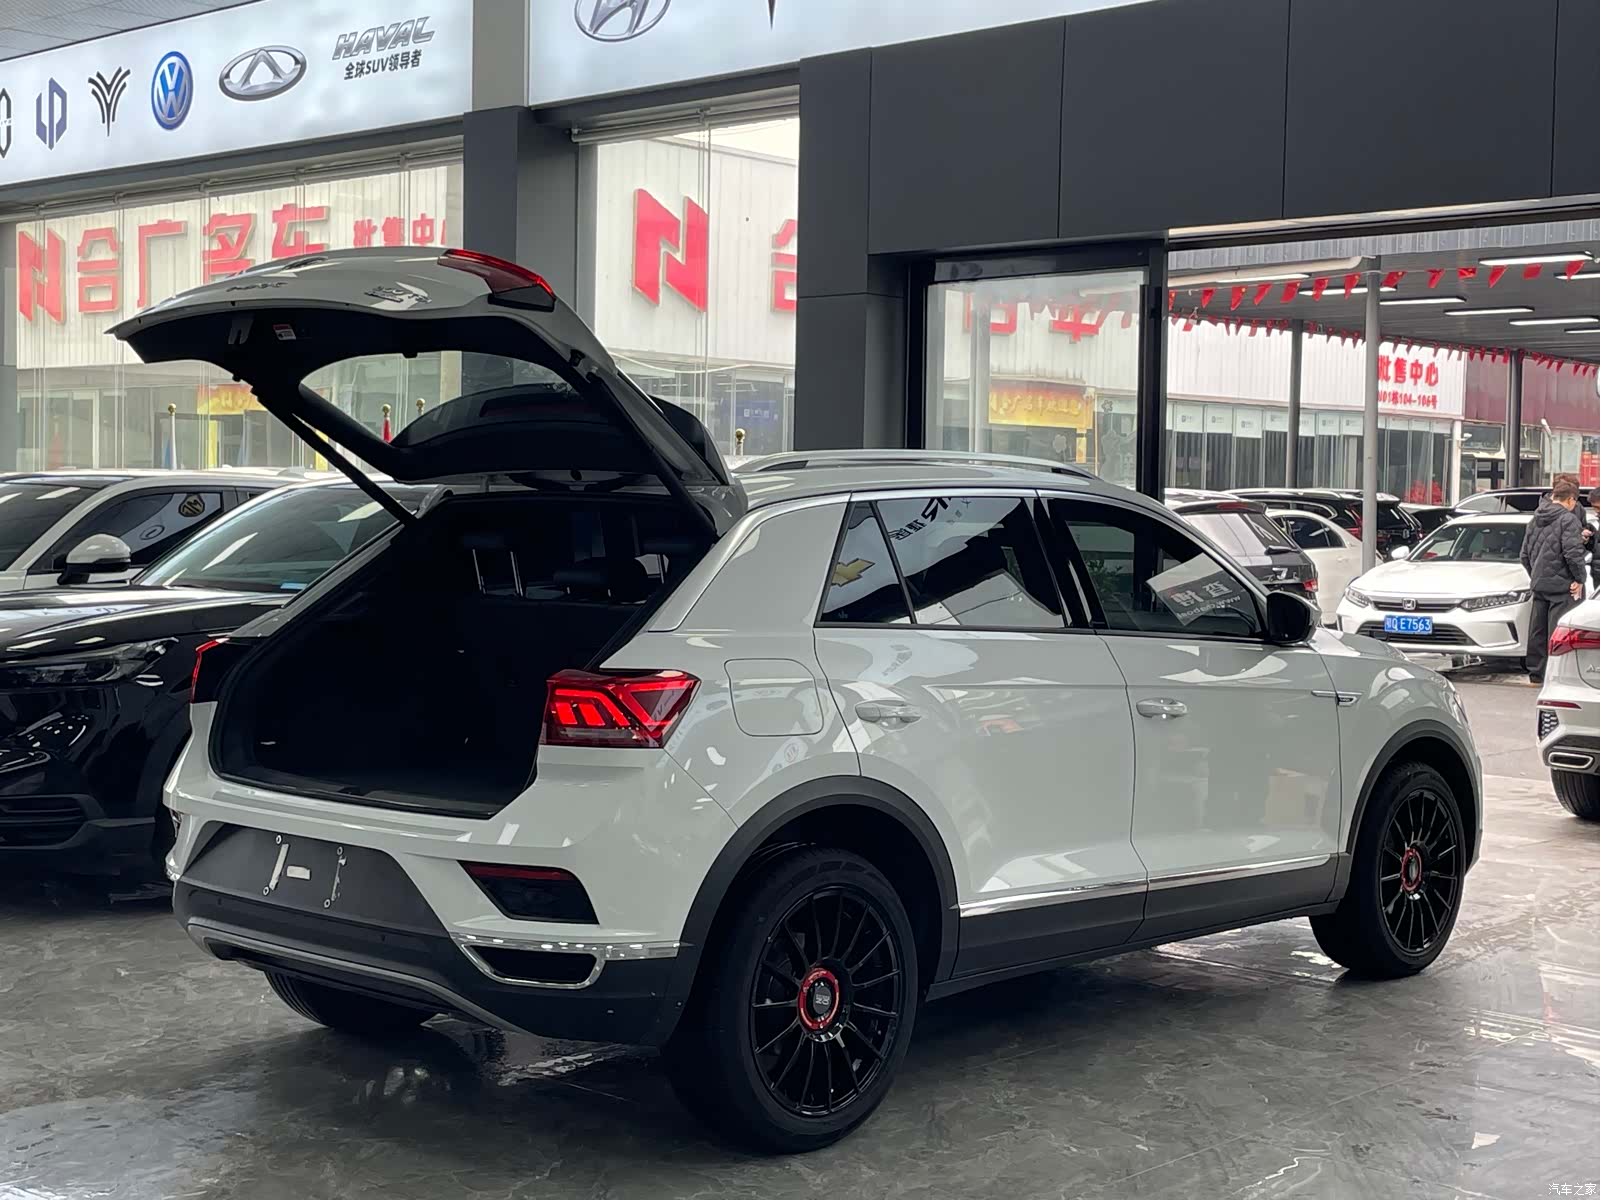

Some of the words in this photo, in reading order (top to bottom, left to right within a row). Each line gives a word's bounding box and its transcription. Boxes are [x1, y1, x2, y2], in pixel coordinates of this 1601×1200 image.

[332, 16, 435, 60] HAVAL
[344, 49, 422, 80] 全球SUV领导者
[353, 213, 446, 248] 批售中
